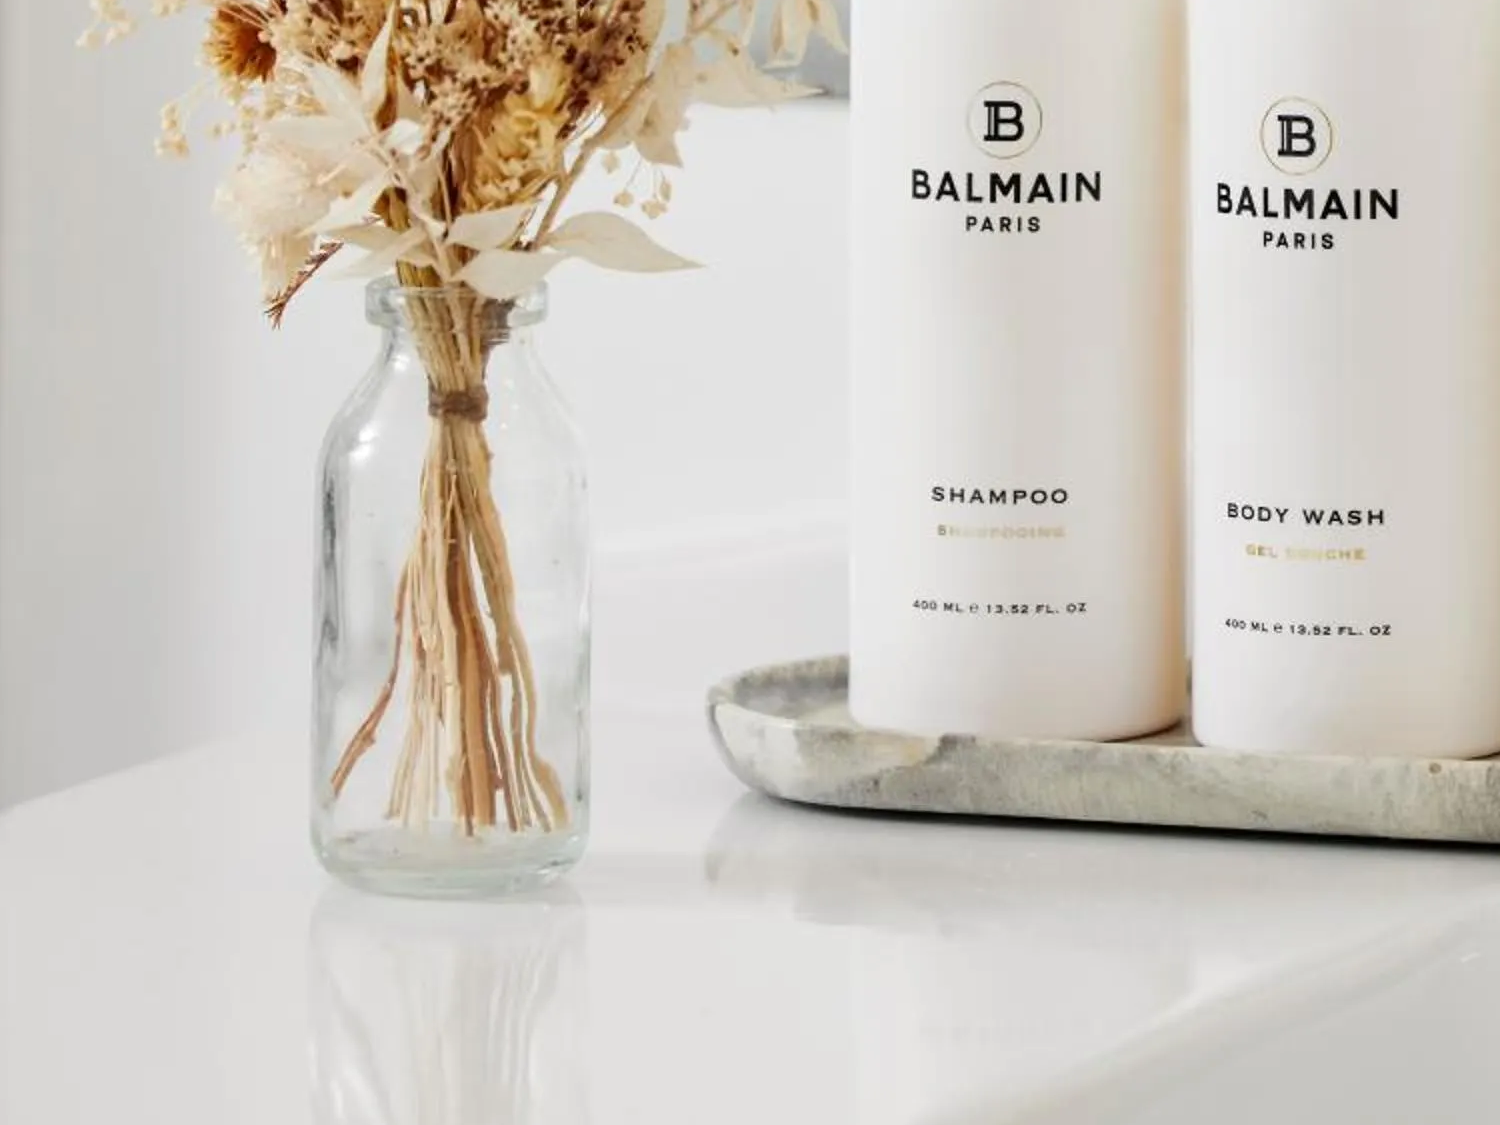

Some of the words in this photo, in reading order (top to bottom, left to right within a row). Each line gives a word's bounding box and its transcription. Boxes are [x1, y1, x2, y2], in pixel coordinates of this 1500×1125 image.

[983, 100, 1025, 142] B
[1276, 114, 1317, 158] B
[911, 168, 1101, 204] BALMAIN
[1217, 182, 1399, 221] BALMAIN
[965, 215, 1041, 234] PARIS
[1262, 230, 1335, 250] PARIS
[931, 486, 1069, 505] SHAMPOO
[1226, 502, 1289, 524] BODY
[1301, 508, 1385, 525] WASH
[911, 599, 938, 612] 400
[943, 602, 964, 614] ML
[986, 603, 1029, 615] 13.52
[1034, 603, 1060, 615] FL.
[1066, 602, 1087, 615] OZ
[1224, 618, 1247, 631] 400
[1251, 621, 1269, 633] ML
[1290, 623, 1332, 636] 13.52
[1337, 625, 1364, 636] FL.
[1369, 624, 1392, 637] OZ
